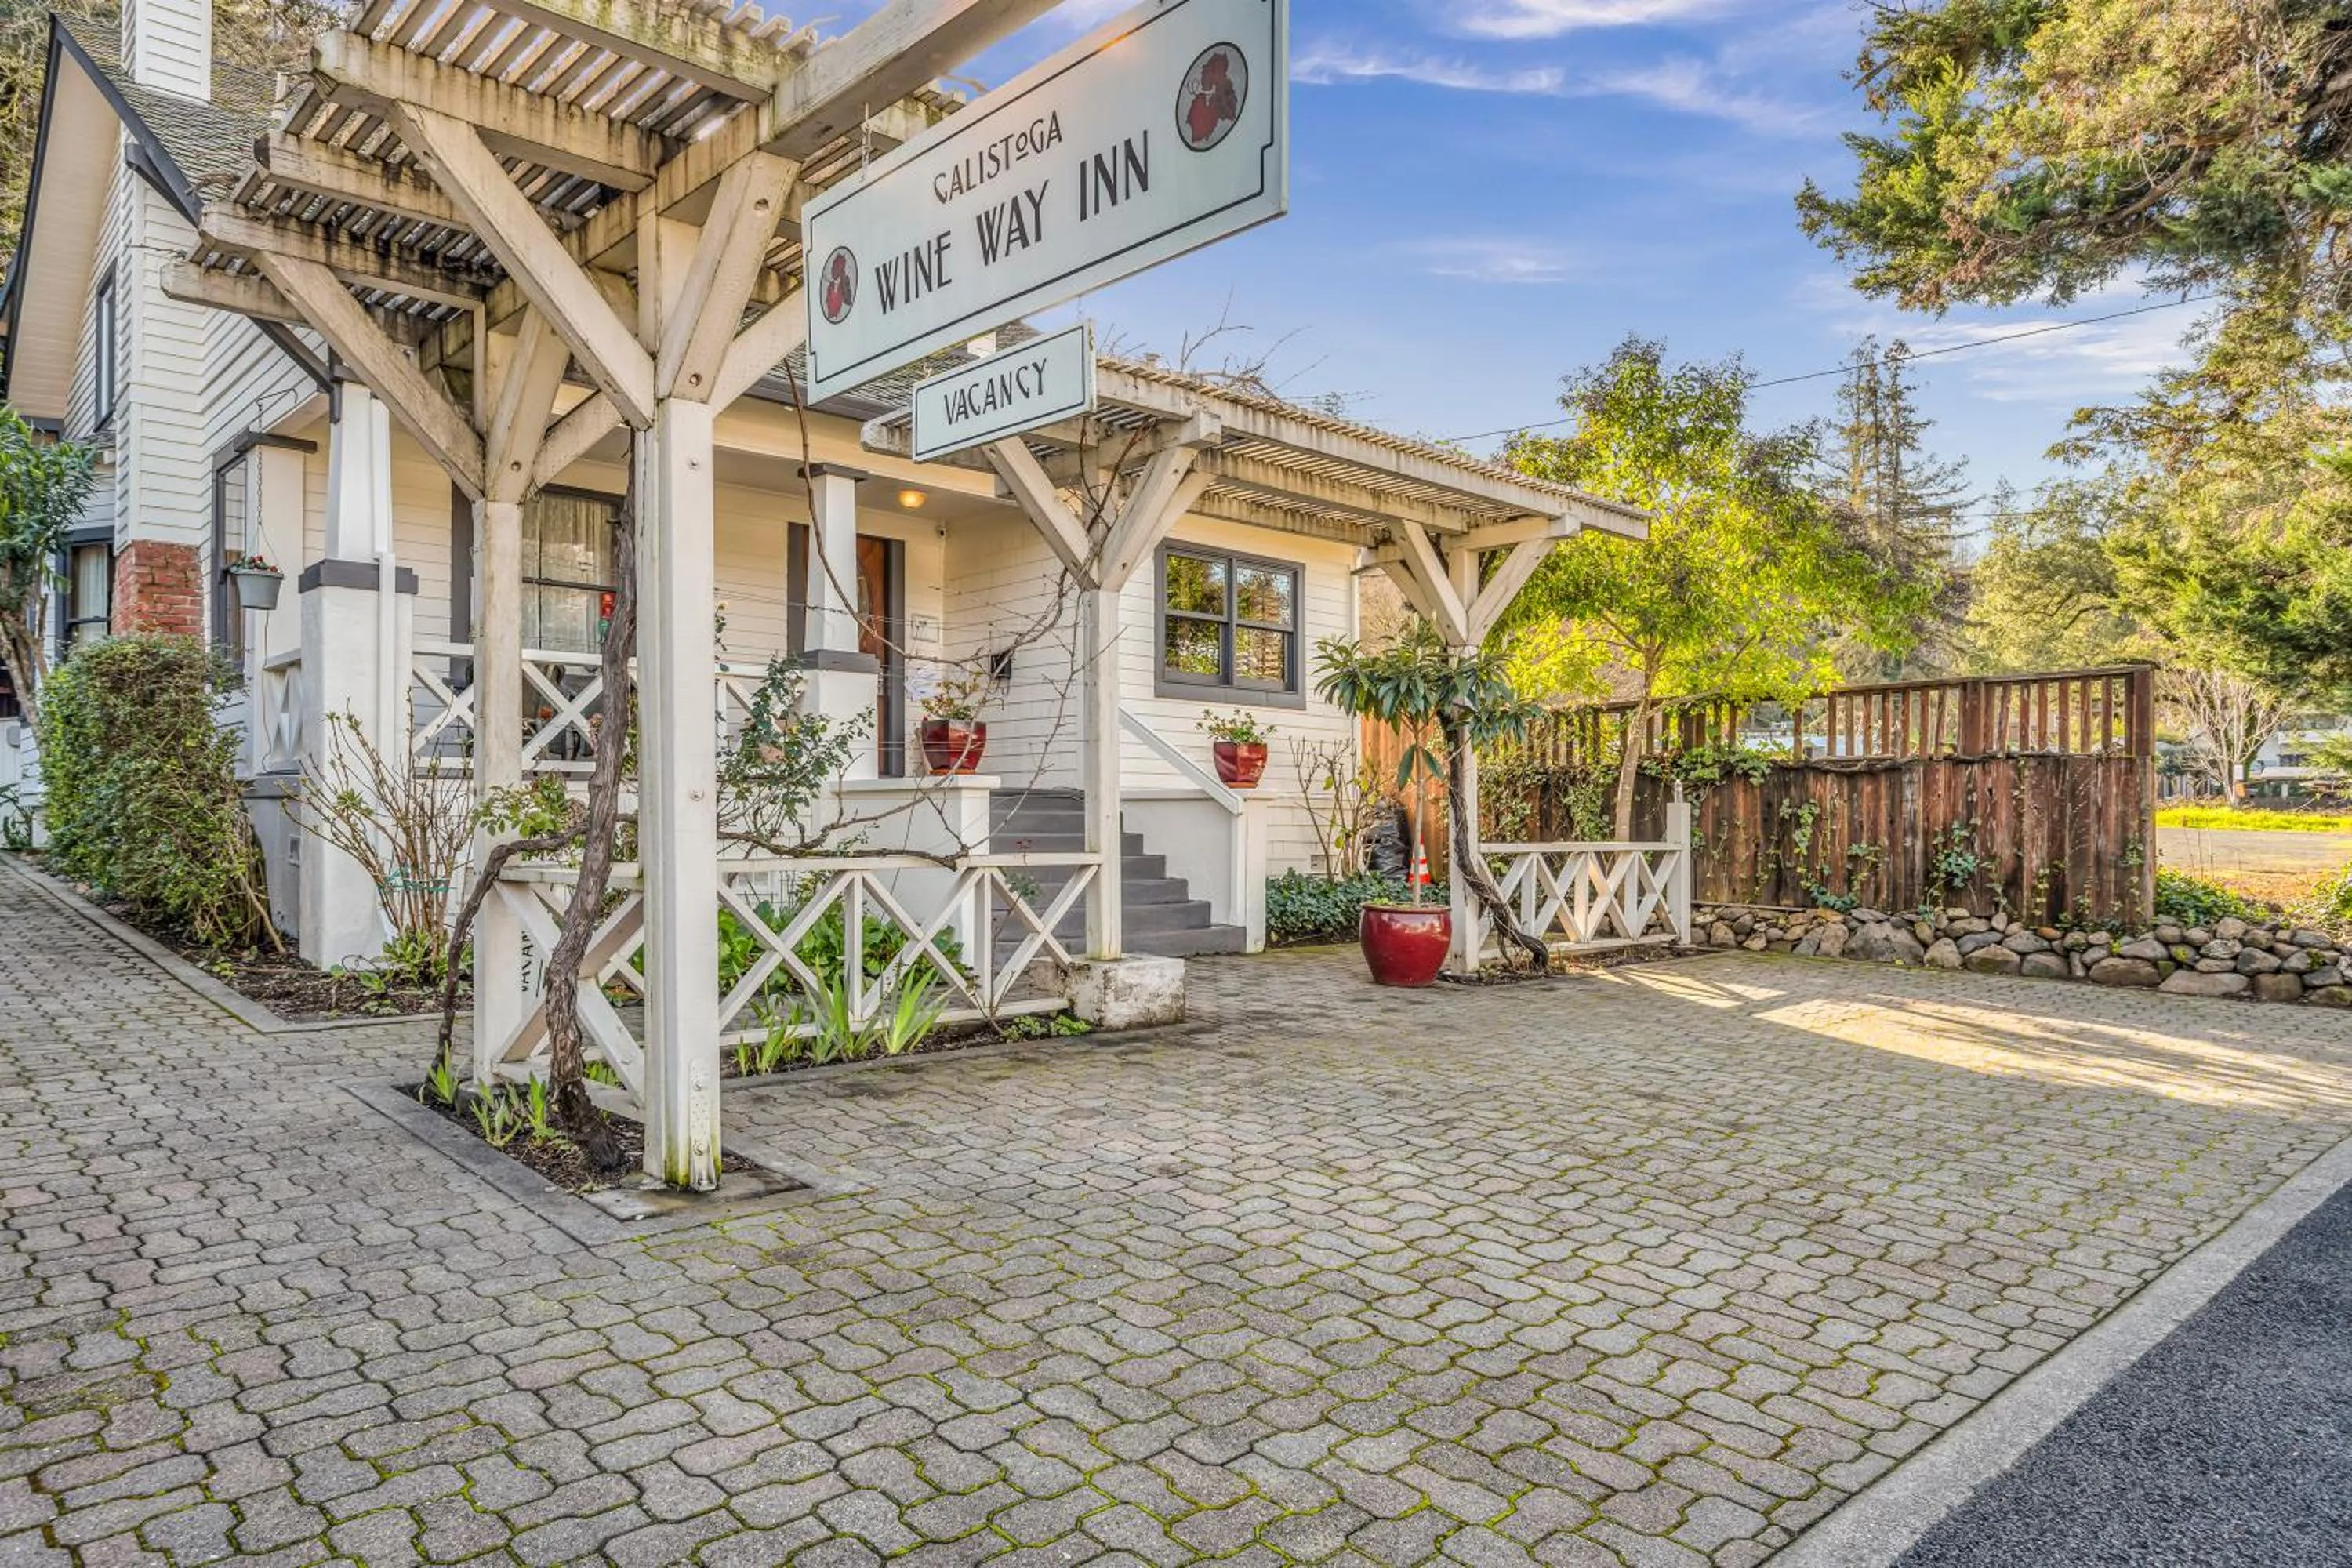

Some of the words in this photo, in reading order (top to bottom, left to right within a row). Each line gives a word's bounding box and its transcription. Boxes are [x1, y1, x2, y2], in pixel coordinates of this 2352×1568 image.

[874, 230, 952, 314] WINE
[976, 180, 1049, 266] WAY
[1080, 129, 1149, 222] INN
[944, 358, 1047, 425] VACANCY
